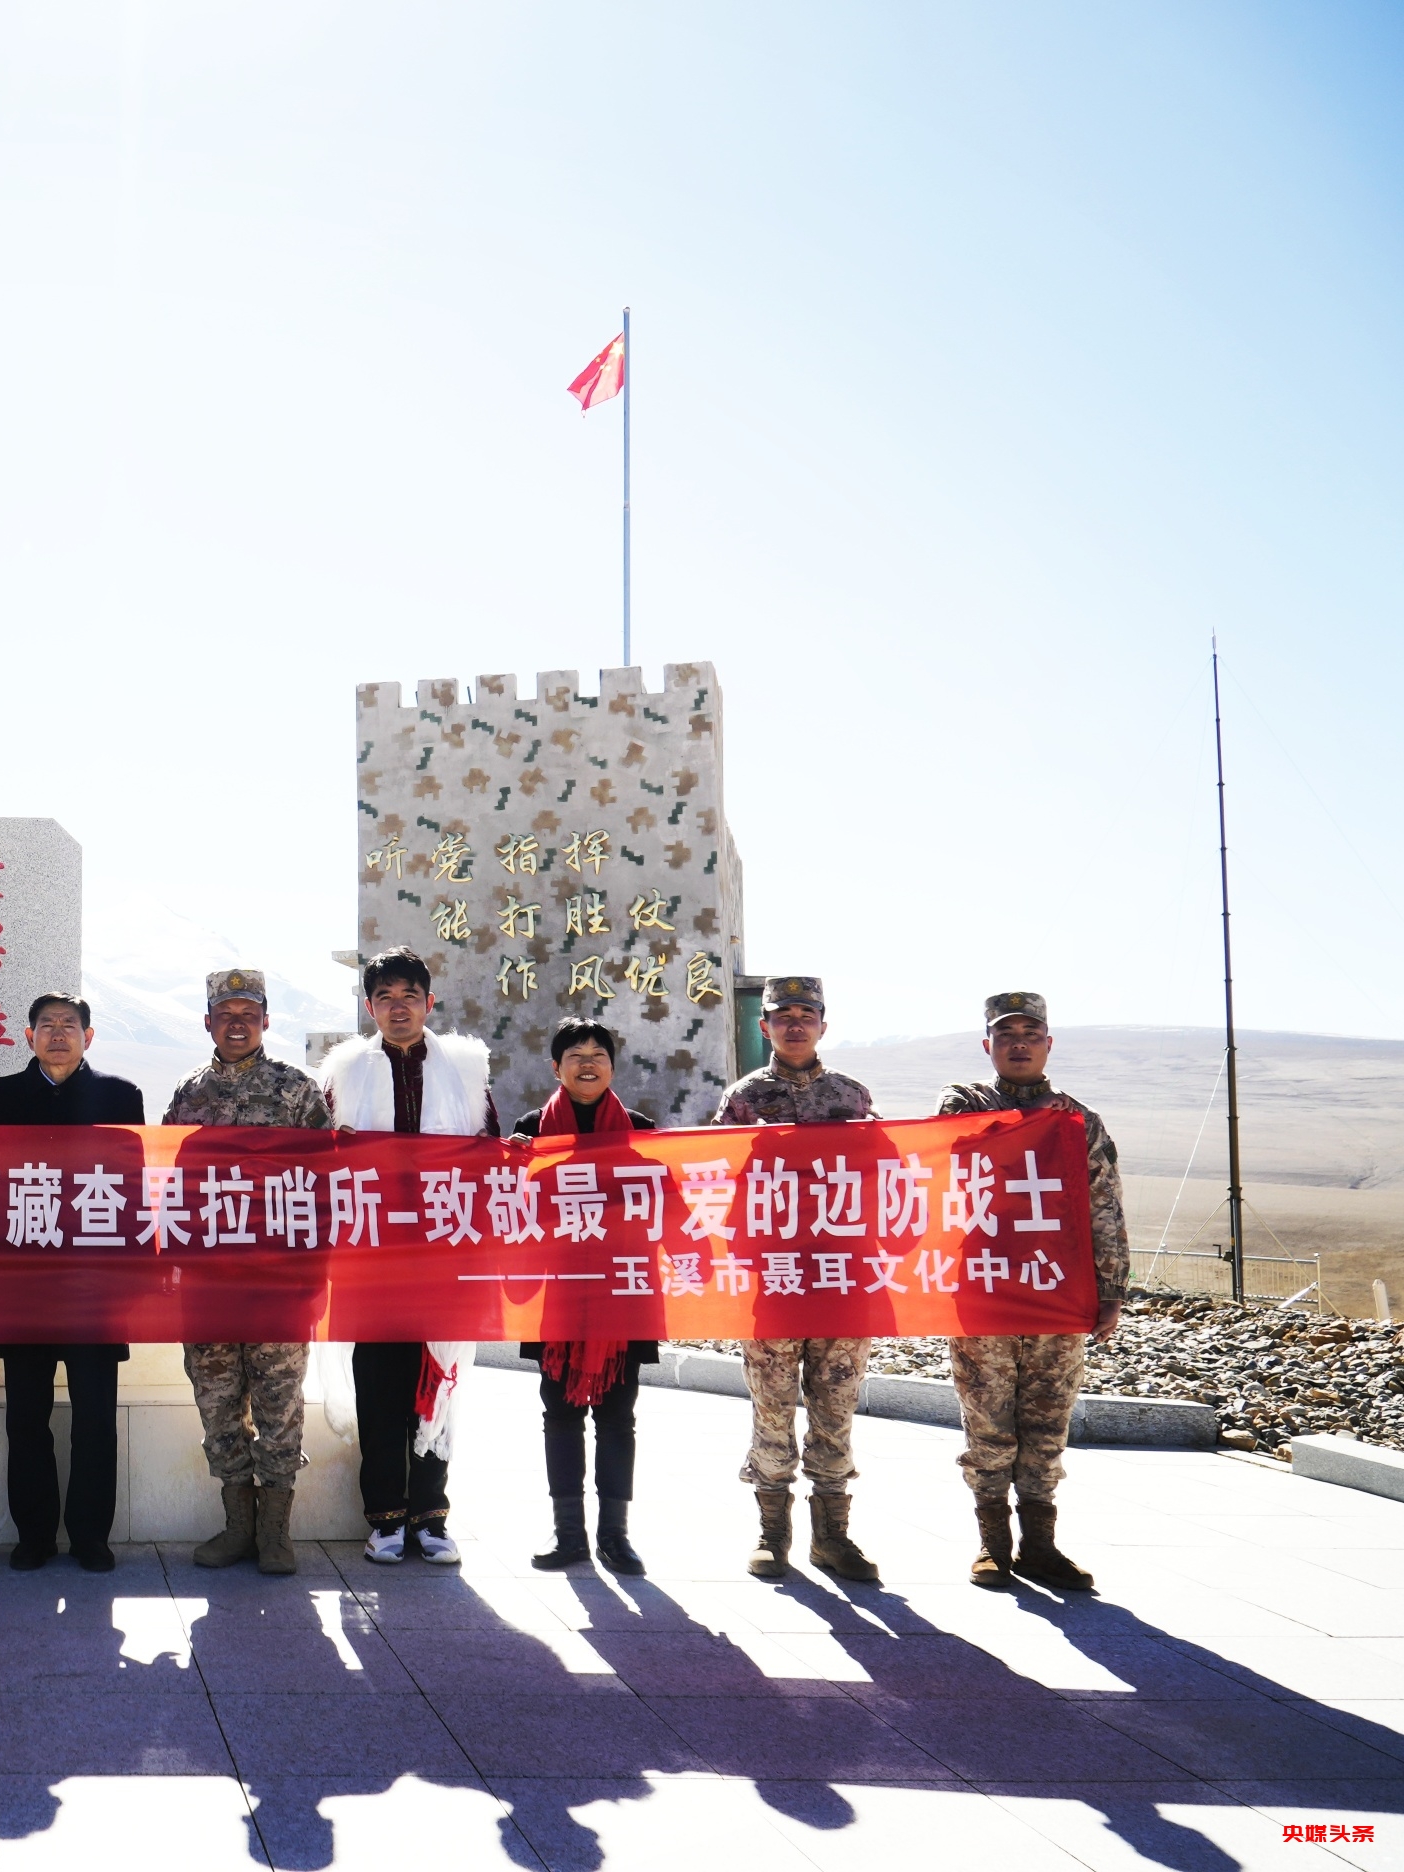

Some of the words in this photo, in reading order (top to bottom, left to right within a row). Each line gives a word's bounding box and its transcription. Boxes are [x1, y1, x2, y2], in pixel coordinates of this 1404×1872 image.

[365, 828, 611, 883] 听党指挥
[429, 888, 675, 940] 能打胜仗
[496, 951, 724, 1004] 作风优良
